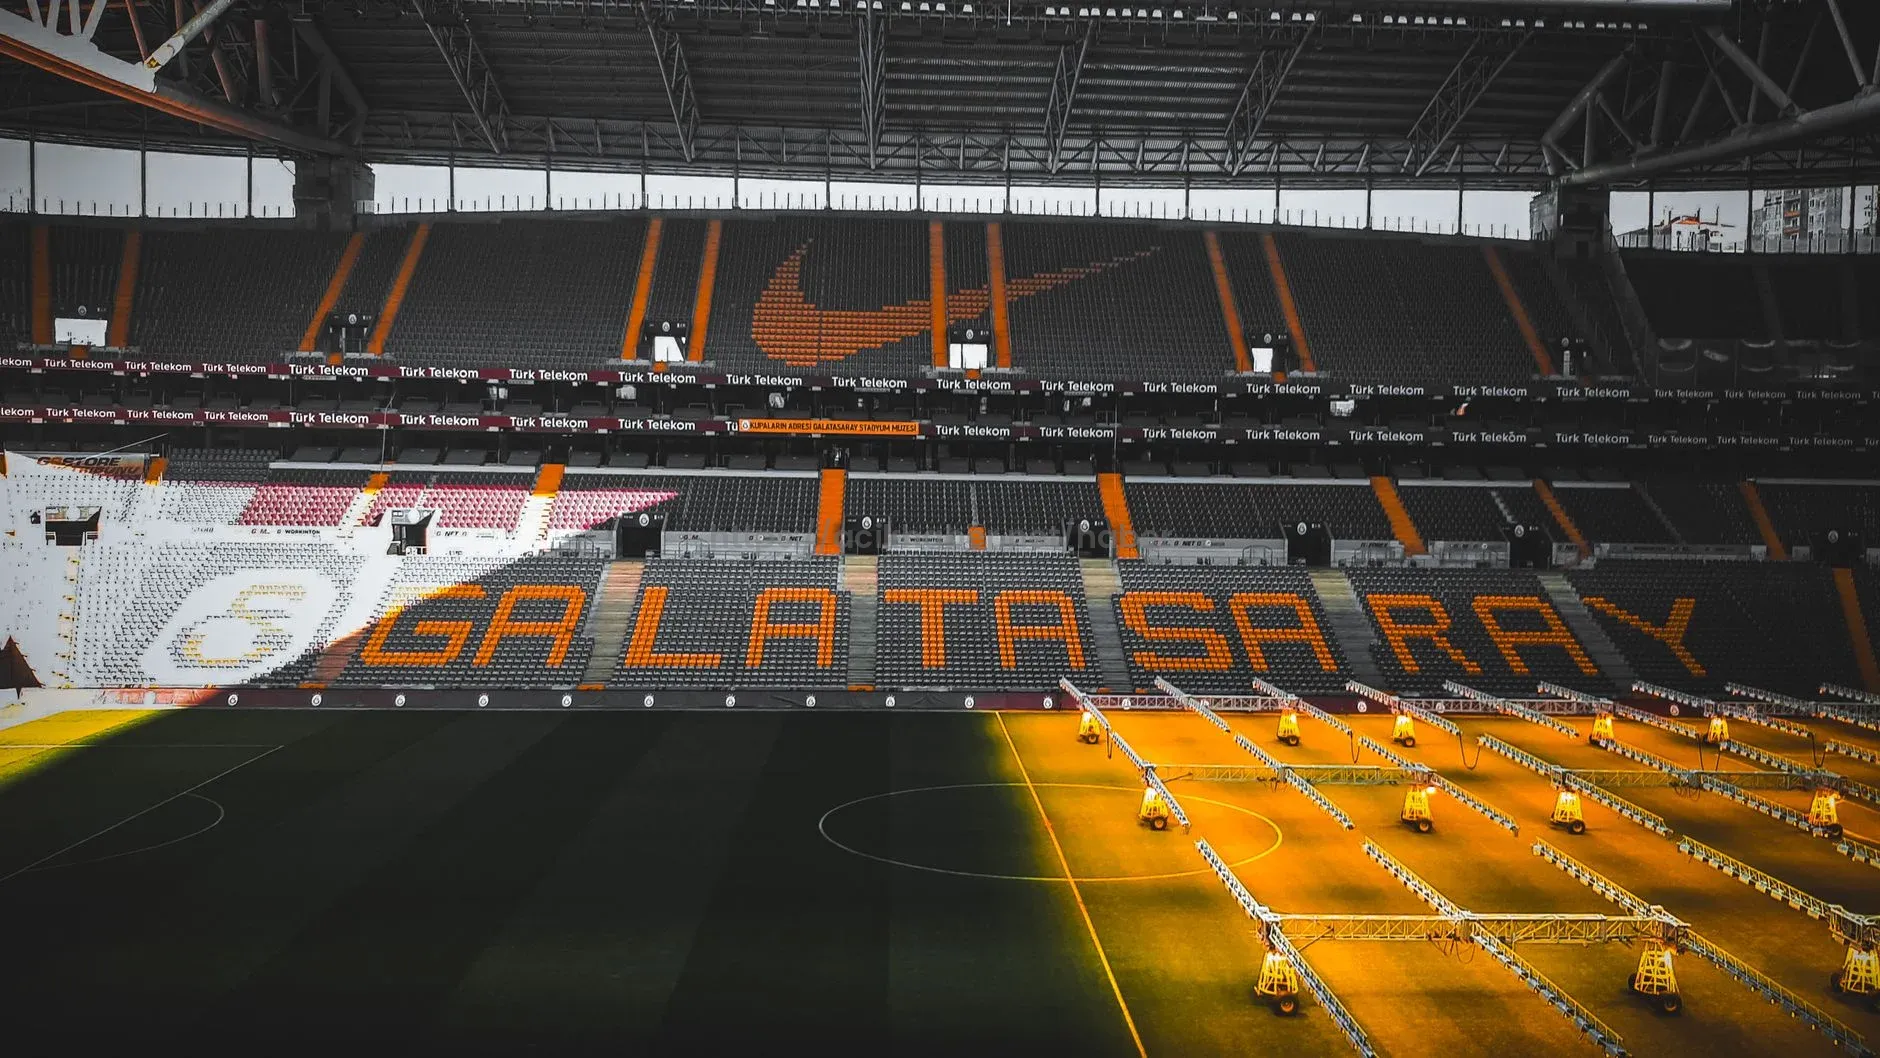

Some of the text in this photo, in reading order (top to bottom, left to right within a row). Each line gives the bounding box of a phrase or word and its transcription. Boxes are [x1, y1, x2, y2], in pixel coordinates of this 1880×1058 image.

[44, 359, 113, 368] Türk Telekom
[150, 362, 191, 371] Telekom
[203, 363, 266, 372] Türk Telekom
[289, 364, 368, 376] Türk Telekom
[399, 367, 478, 378] Türk Telekom
[510, 369, 587, 380] Türk Telekom
[618, 372, 695, 383] Türk Telekom
[726, 374, 802, 385] Türk Telekom
[832, 376, 907, 388] Türk Telekom
[937, 379, 1010, 389] Türk Telekom
[1040, 381, 1114, 391] Türk Telekom
[1143, 382, 1217, 392] Türk Telekom
[1247, 384, 1320, 393] Türk Telekom
[1350, 385, 1423, 395] Türk Telekom
[1453, 386, 1527, 396] Türk Telekom
[1557, 387, 1629, 397] Türk Telekom
[1676, 388, 1713, 397] Telekom
[1747, 389, 1785, 398] Telekom
[1821, 390, 1860, 399] Telekom
[46, 408, 115, 417] Türk Telekom
[127, 410, 193, 419] Türk Telekom
[228, 412, 268, 420] Telekom
[289, 412, 368, 423] Türk Telekom
[400, 415, 479, 426] Türk Telekom
[510, 417, 588, 428] Türk Telekom
[618, 419, 695, 430] Türk Telekom
[725, 421, 738, 431] Tü
[750, 421, 787, 430] KUPALARIN
[813, 422, 858, 431] GALATASARAY
[859, 423, 890, 432] STADYUM
[936, 425, 1009, 436] Türk Telekom
[1040, 427, 1113, 437] Türk Telekom
[1143, 428, 1216, 439] Türk Telekom
[1246, 430, 1319, 440] Türk Telekom
[1349, 431, 1423, 441] Türk Telekom
[1453, 432, 1526, 442] Türk Telekom
[1556, 433, 1629, 443] Türk Telekom
[1670, 435, 1707, 444] Telekom
[1740, 435, 1778, 444] Telekom
[1813, 436, 1852, 445] Telekom
[361, 584, 1707, 677] GALATASARAY
